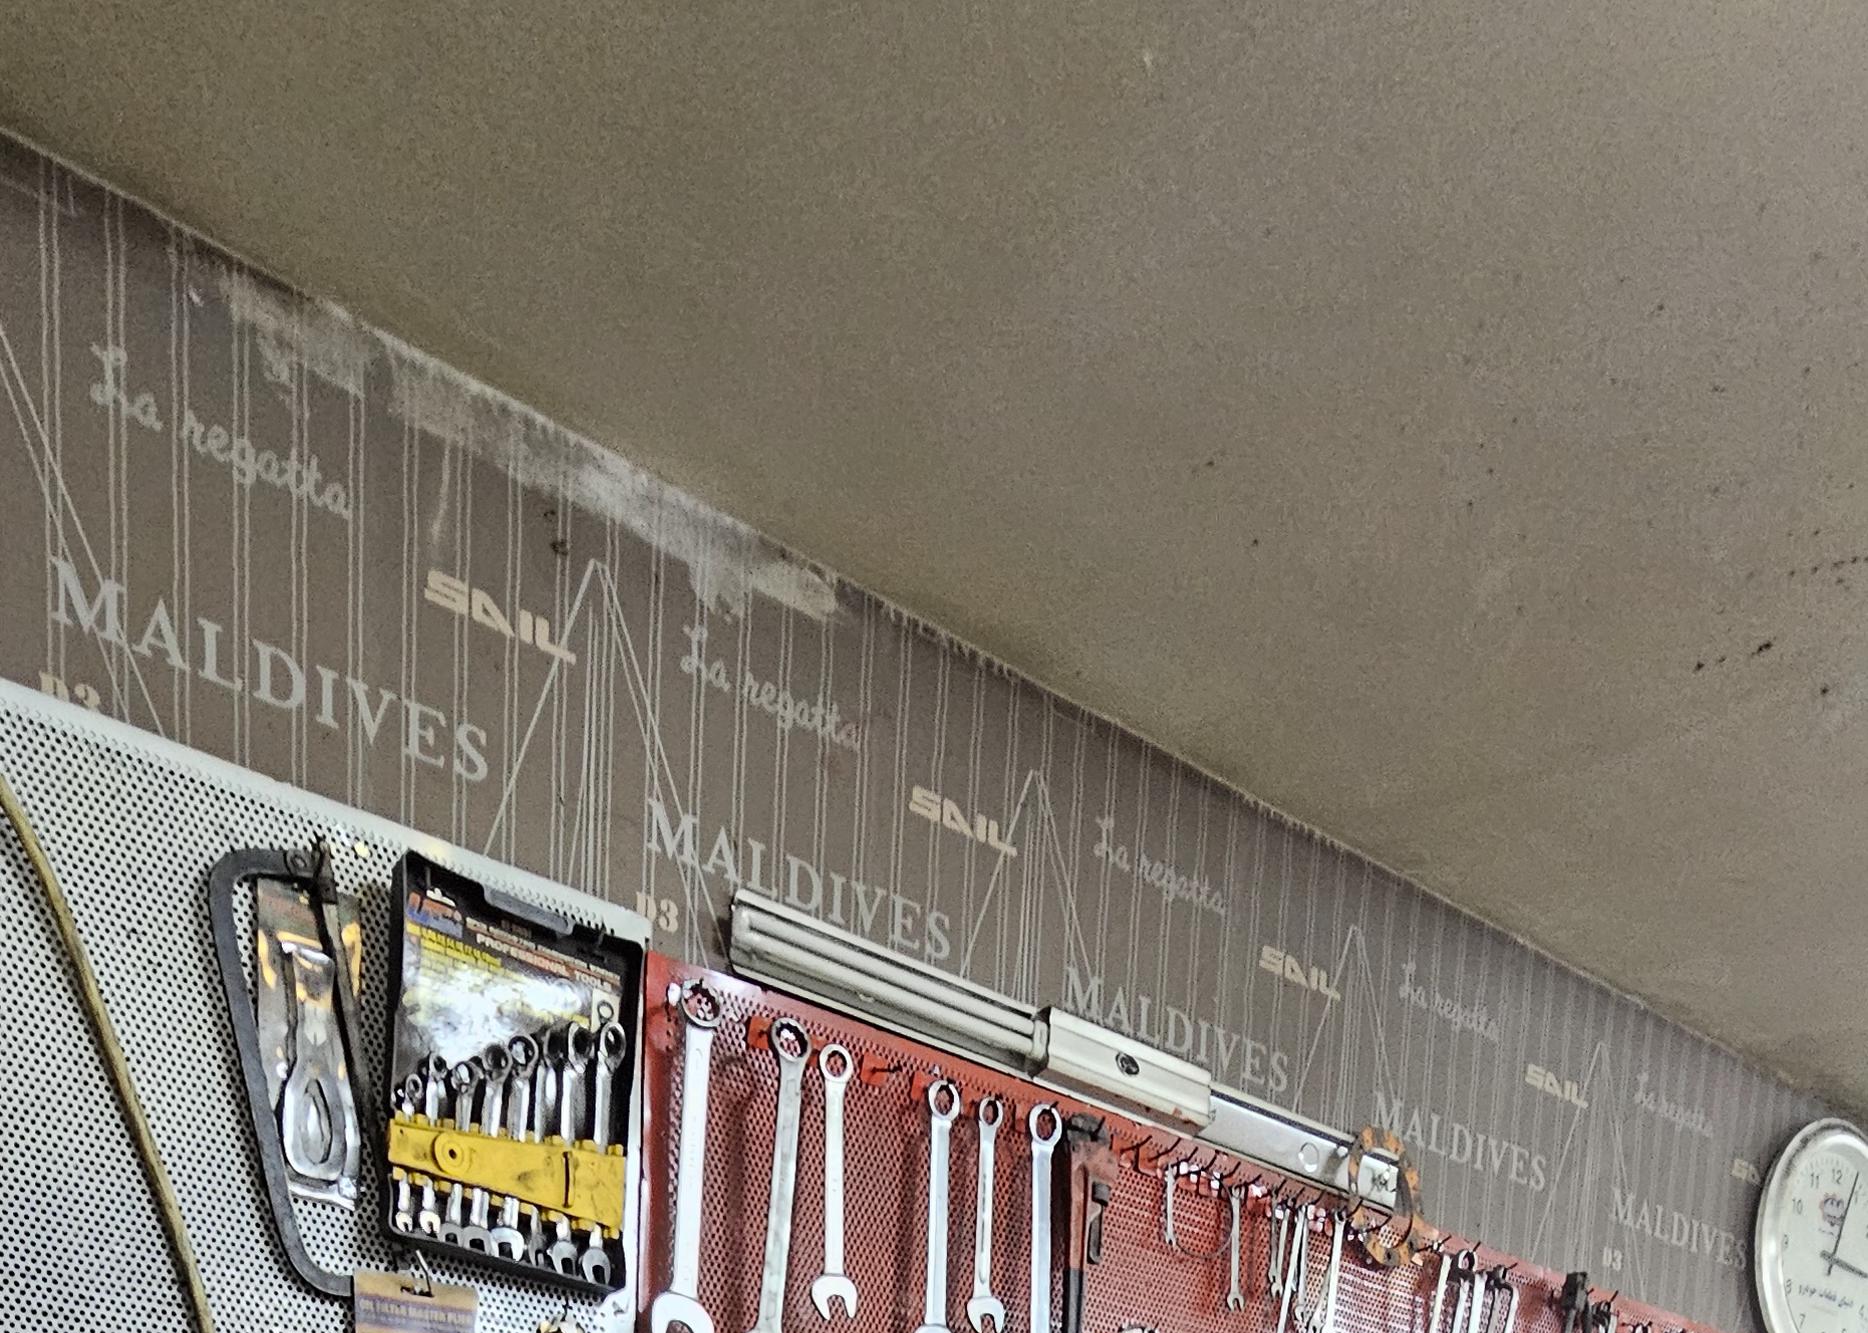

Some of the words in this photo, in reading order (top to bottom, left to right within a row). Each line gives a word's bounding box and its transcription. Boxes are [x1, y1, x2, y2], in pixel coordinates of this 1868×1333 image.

[424, 569, 577, 666] SAIL
[50, 555, 490, 783] MALDIVES
[908, 784, 1018, 860] SAIL
[646, 799, 952, 961] MALDIVES
[1258, 945, 1341, 1002] SAIL
[1063, 965, 1289, 1094] MALDIVES
[1524, 1063, 1588, 1109] SAIL
[1373, 1091, 1547, 1193] MALDIVES
[1731, 1158, 1760, 1186] SA
[1608, 1186, 1748, 1271] MALDIVES
